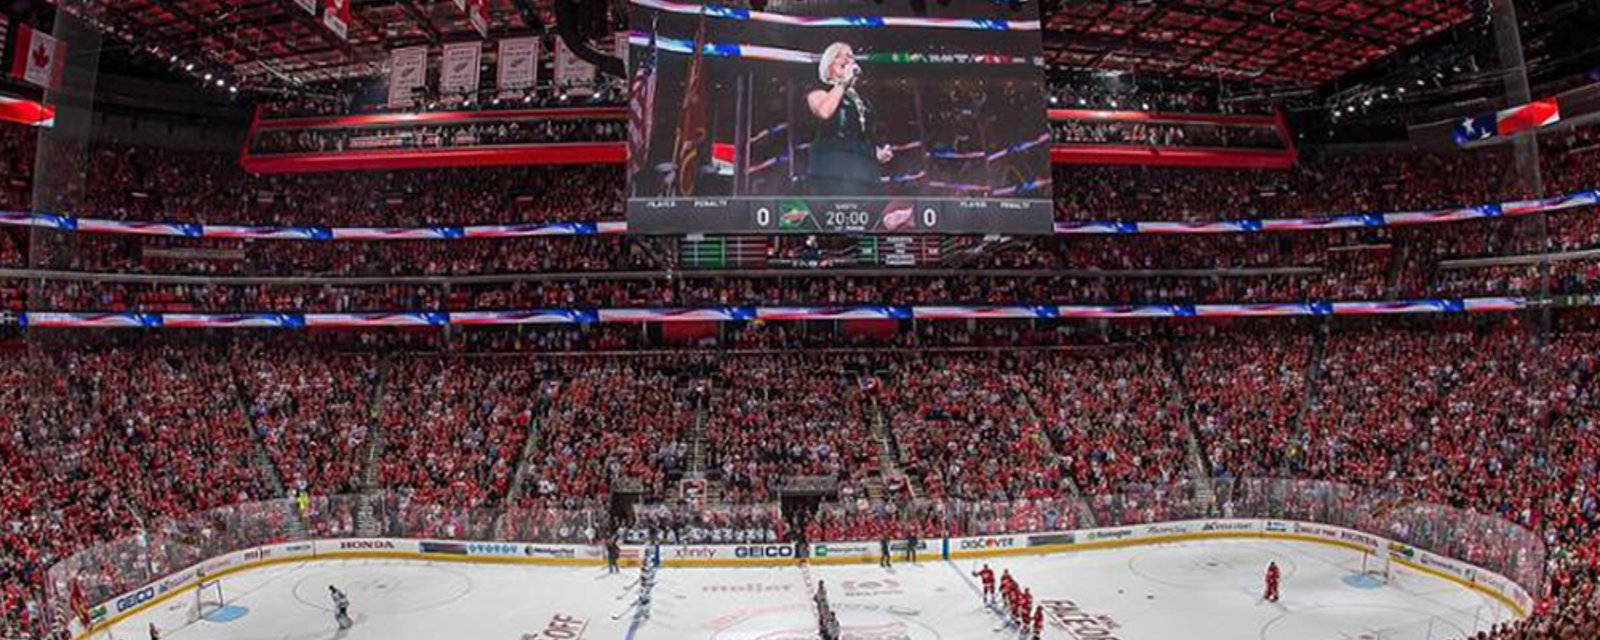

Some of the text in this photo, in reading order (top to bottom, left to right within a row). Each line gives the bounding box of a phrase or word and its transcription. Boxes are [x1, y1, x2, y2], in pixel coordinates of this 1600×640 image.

[756, 207, 770, 226] 0
[826, 211, 869, 226] 20:00
[923, 208, 937, 227] 0
[340, 540, 395, 549] HONDA
[960, 537, 1014, 550] DISCOVER
[674, 545, 717, 559] xfinity
[735, 545, 793, 558] GEICO
[116, 587, 154, 612] GEICO
